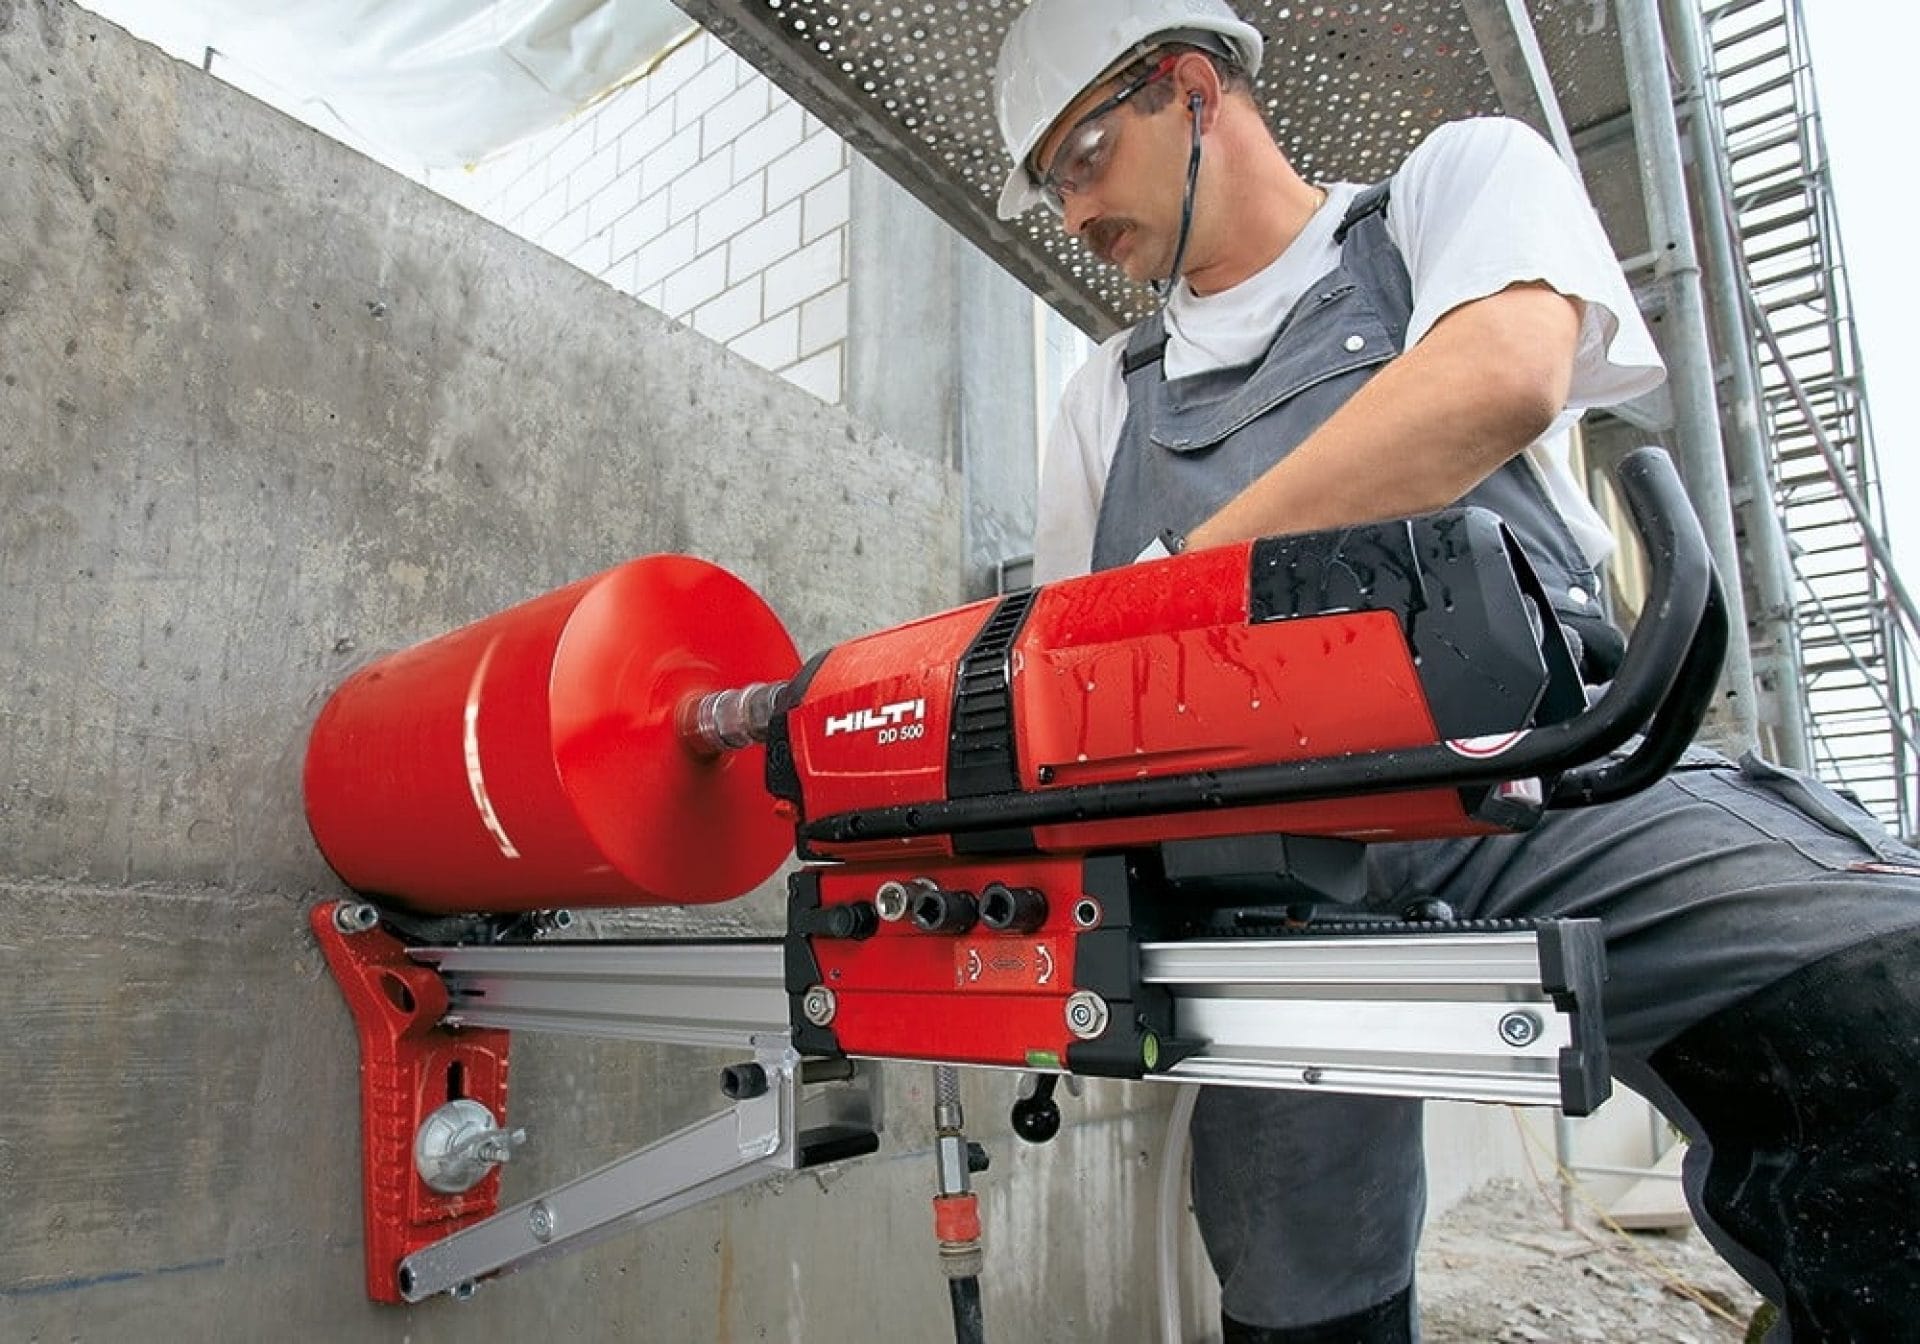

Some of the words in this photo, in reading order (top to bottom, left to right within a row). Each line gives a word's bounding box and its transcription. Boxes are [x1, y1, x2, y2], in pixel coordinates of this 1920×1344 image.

[825, 698, 925, 736] HILTI
[878, 728, 897, 744] DD
[900, 723, 924, 740] 500
